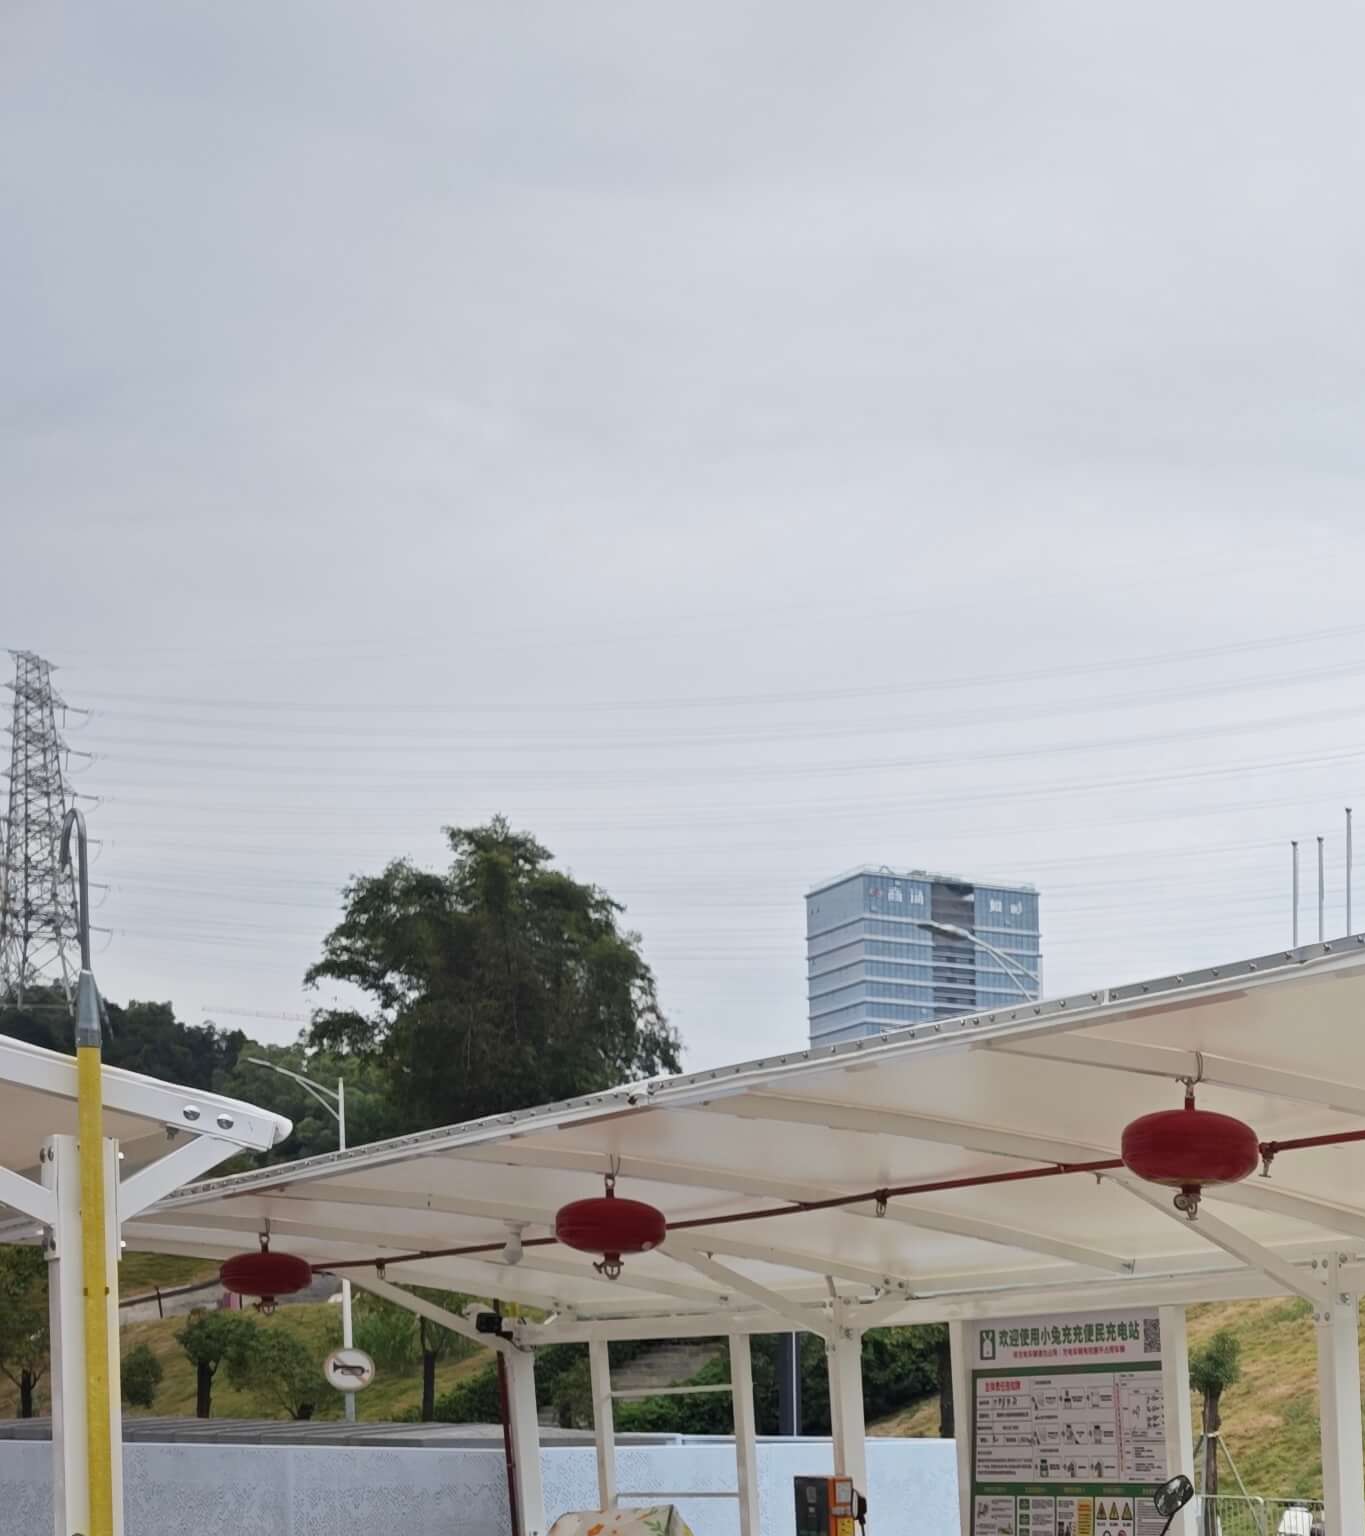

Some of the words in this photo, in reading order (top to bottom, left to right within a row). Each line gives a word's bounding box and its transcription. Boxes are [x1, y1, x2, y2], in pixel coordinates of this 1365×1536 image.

[999, 1320, 1140, 1348] 欢迎使用小兔充充便民充电站
